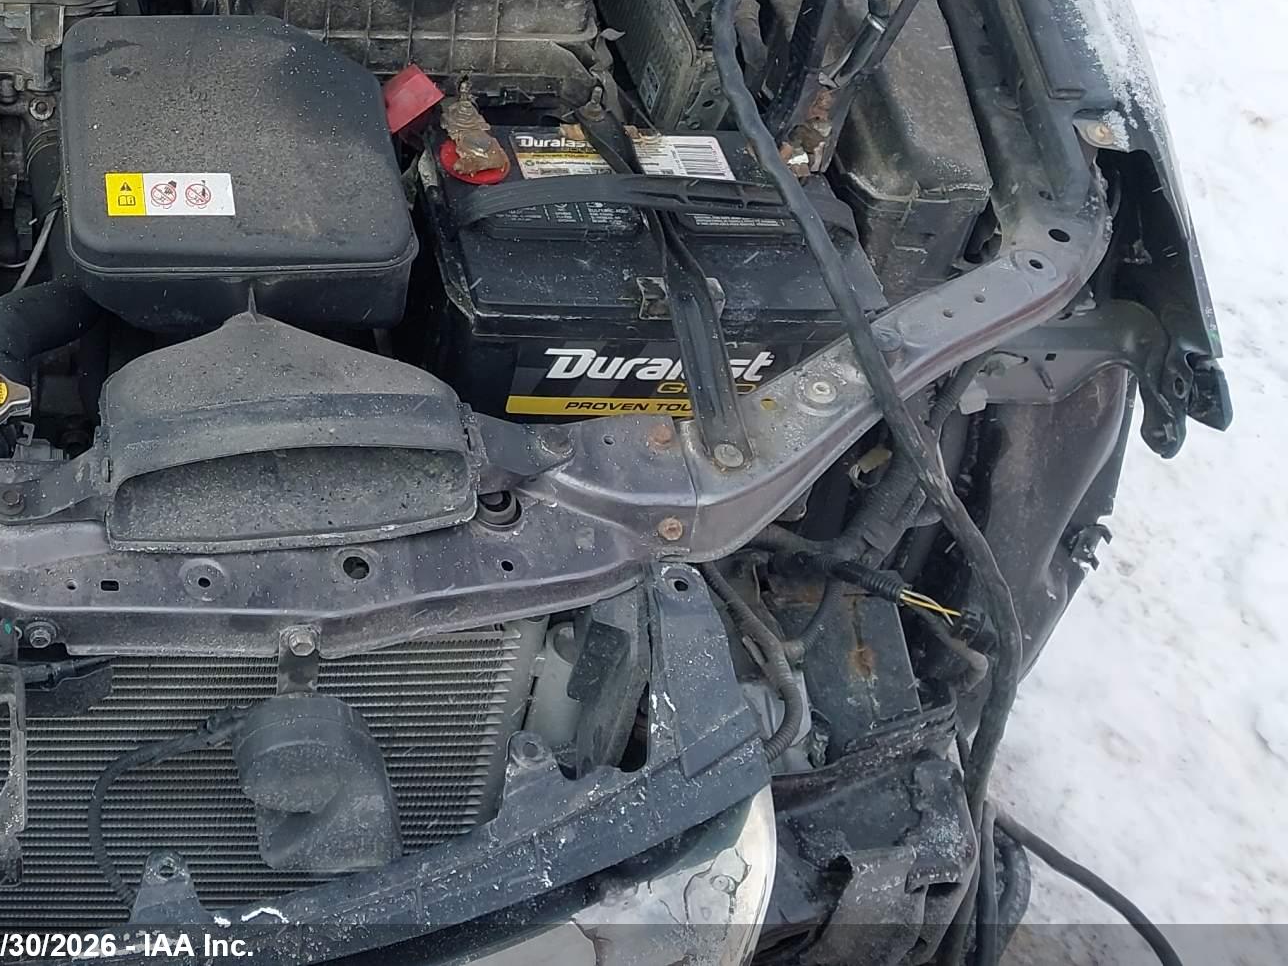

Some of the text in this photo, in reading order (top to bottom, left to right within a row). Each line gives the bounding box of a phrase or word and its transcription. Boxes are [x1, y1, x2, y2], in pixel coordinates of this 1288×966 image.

[544, 347, 773, 381] Duralst
[657, 382, 757, 395] GD
[565, 401, 693, 412] PROVEN TOU
